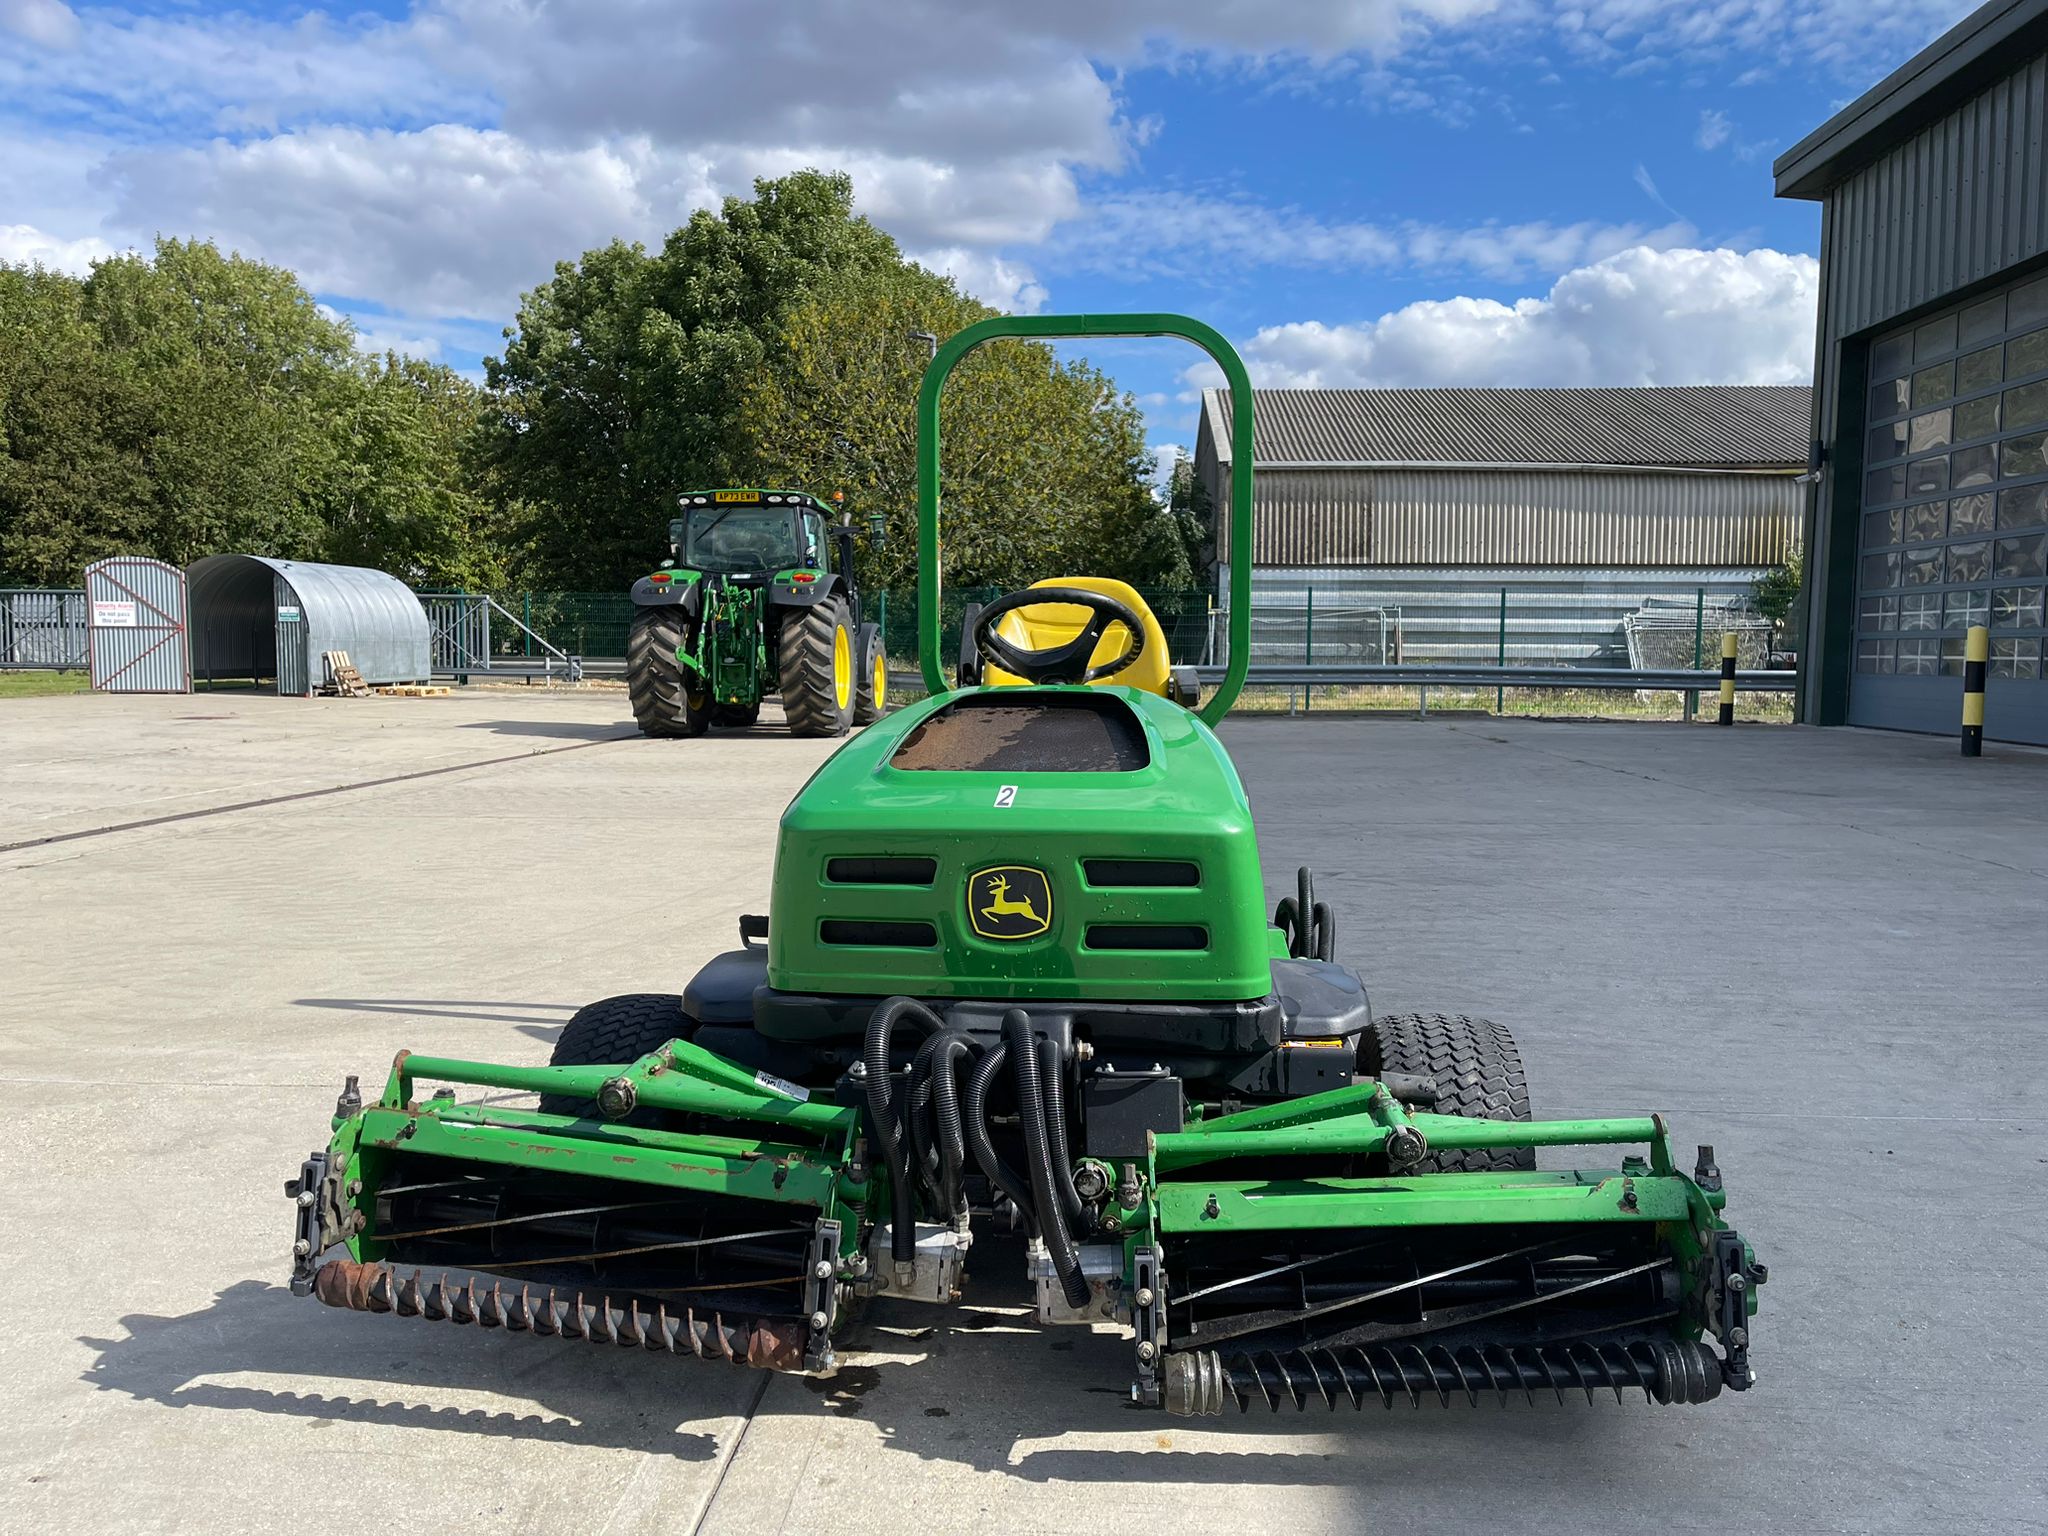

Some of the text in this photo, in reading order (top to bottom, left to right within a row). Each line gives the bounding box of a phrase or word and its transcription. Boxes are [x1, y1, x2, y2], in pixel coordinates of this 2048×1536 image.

[719, 492, 756, 500] AP73 EWR
[996, 787, 1014, 806] 2
